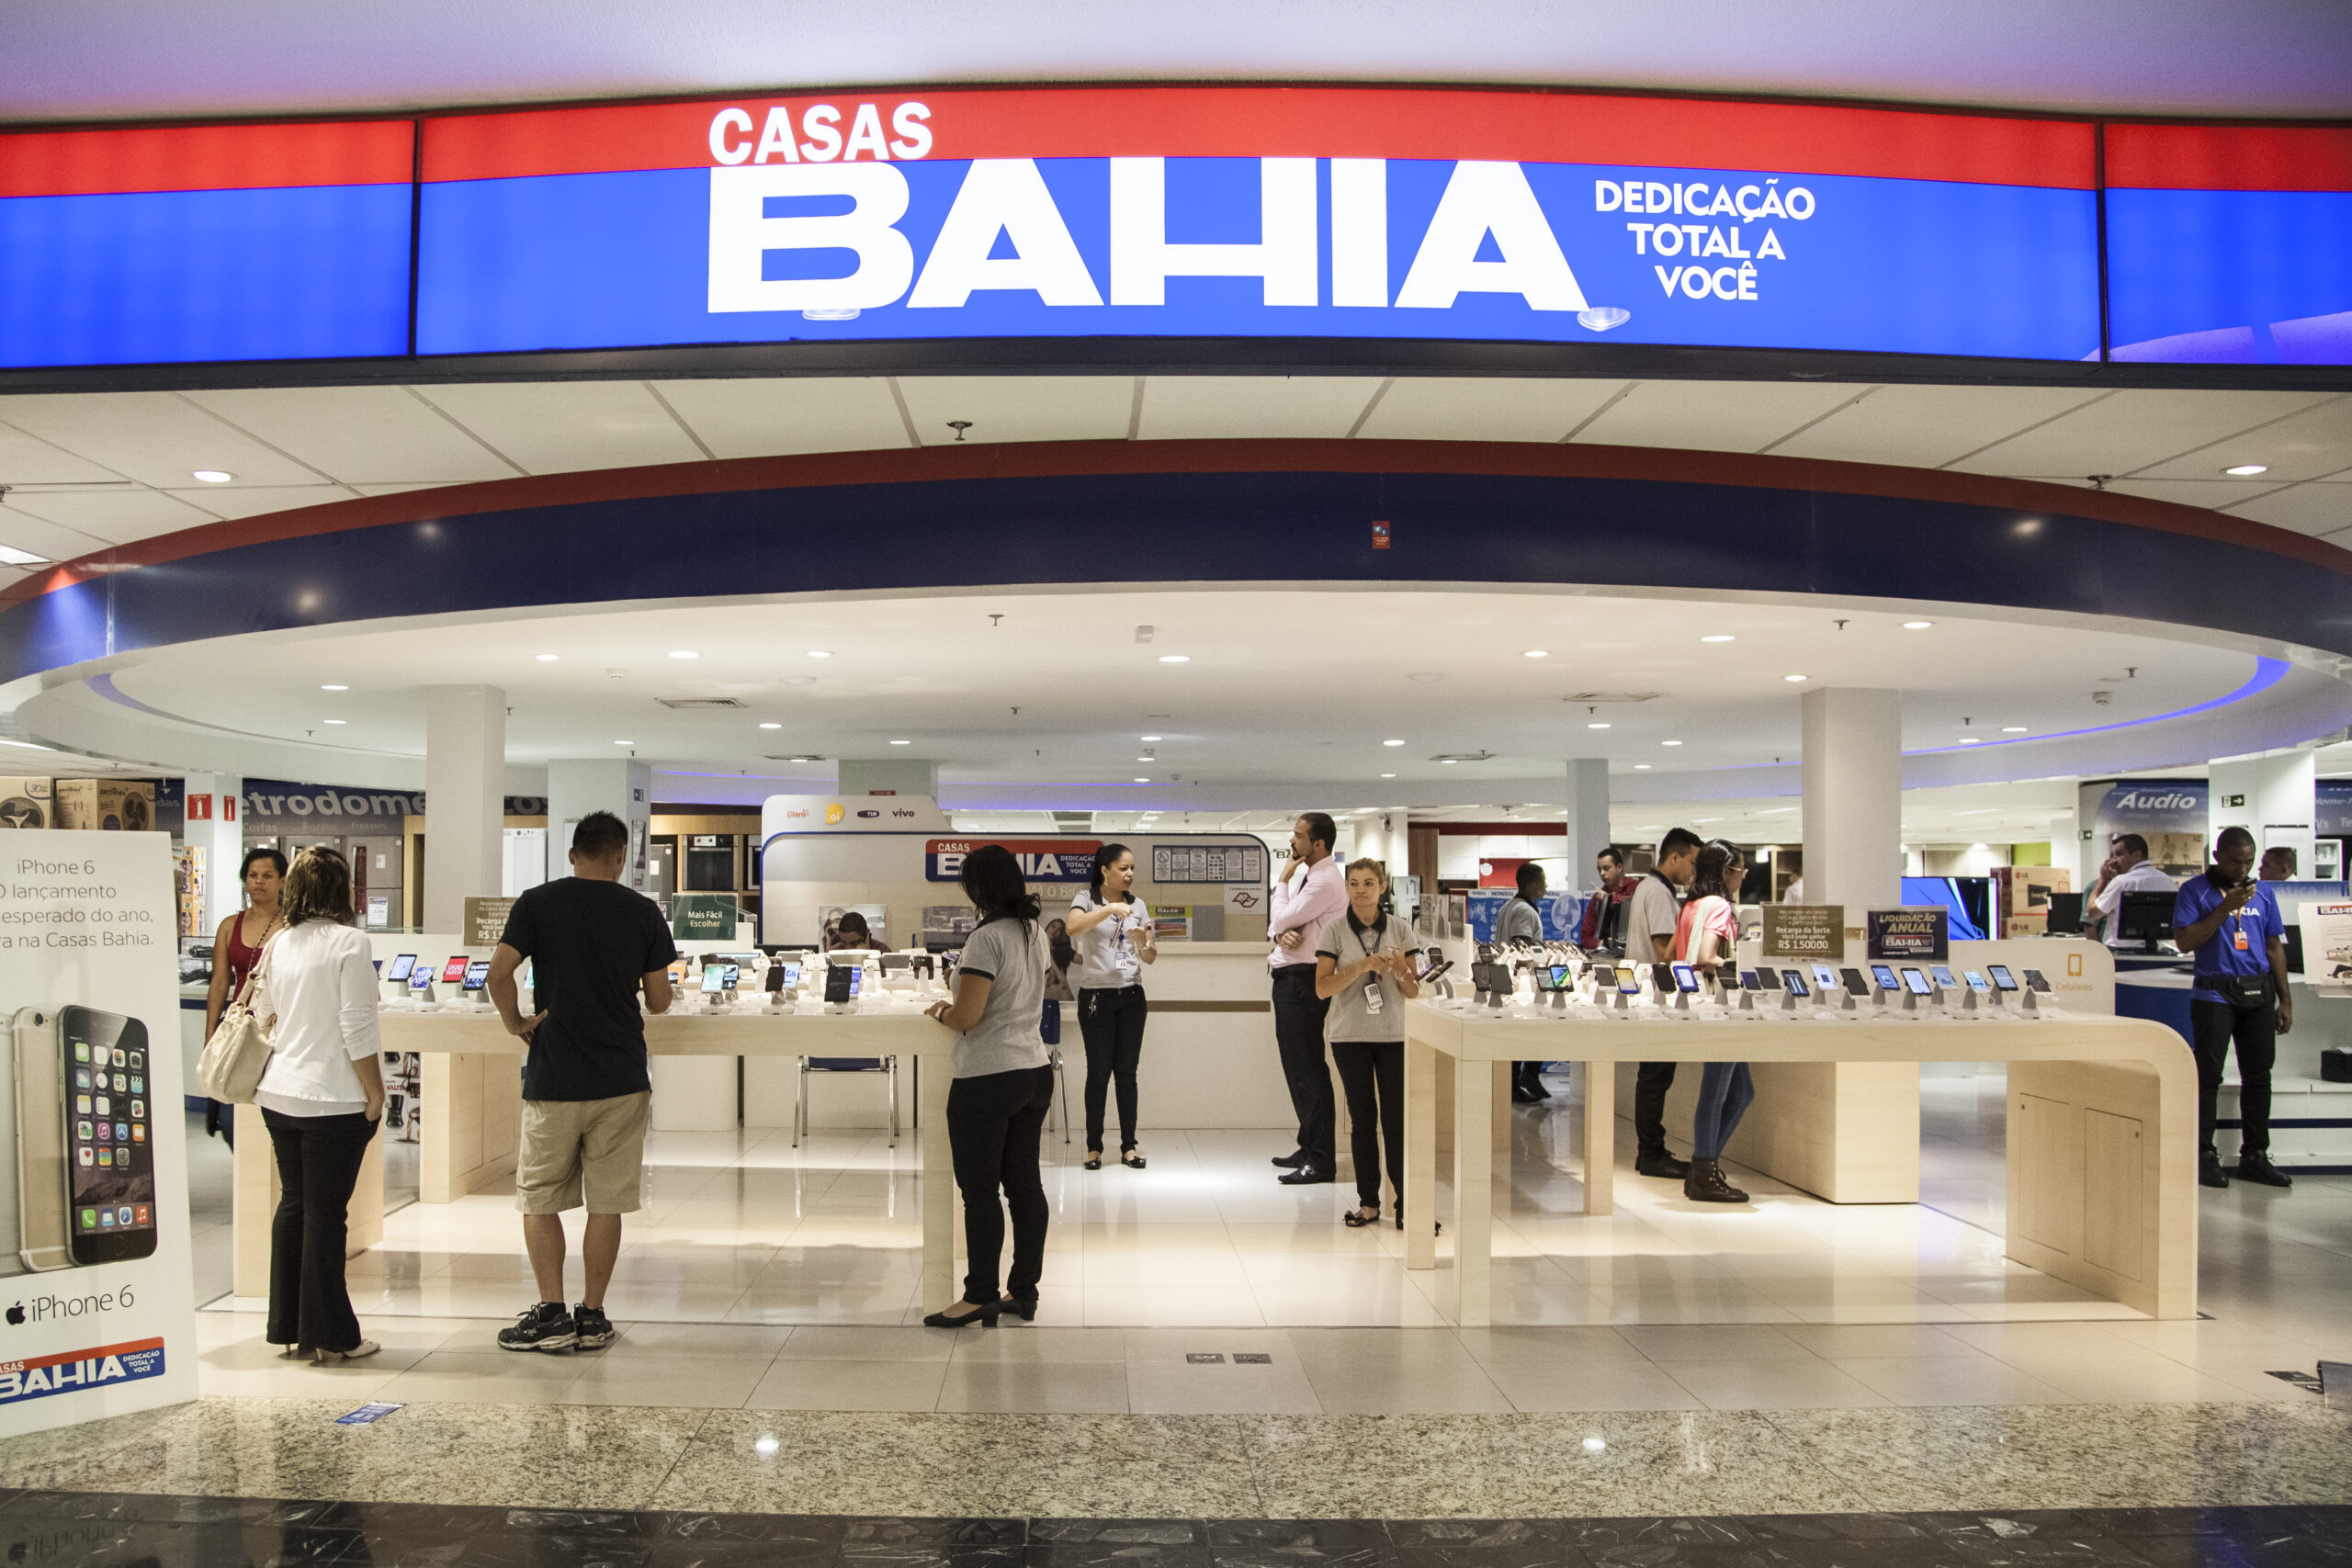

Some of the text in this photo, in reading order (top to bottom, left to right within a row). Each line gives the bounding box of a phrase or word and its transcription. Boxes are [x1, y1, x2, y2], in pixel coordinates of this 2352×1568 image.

[708, 101, 933, 165] CASAS
[1595, 178, 1815, 223] DEDICAÇÃO
[707, 157, 1590, 312] BAHIA
[1627, 222, 1786, 260] TOTAL A
[1654, 260, 1758, 300] VOCÊ
[2117, 791, 2197, 809] Áudio
[892, 808, 915, 818] vivo
[937, 842, 970, 852] CASAS
[17, 859, 96, 874] iPhone 6
[12, 883, 117, 900] lançamento
[1, 908, 153, 926] esperado do ano,
[687, 910, 705, 919] Mais
[1879, 913, 1937, 923] LIQUIDAÇÃO
[476, 918, 501, 926] Recarga
[690, 919, 720, 928] Escolher
[1887, 922, 1933, 933] ANUAL
[479, 931, 490, 940] R$
[1775, 926, 1802, 934] Recarga
[18, 936, 40, 948] na
[46, 931, 97, 948] Casas
[103, 931, 154, 946] Bahia.
[1779, 940, 1791, 949] R$
[2055, 982, 2094, 991] Celulares
[31, 1284, 134, 1322] iPhone 6
[123, 1349, 160, 1362] DEDICAÇÃO
[129, 1359, 149, 1368] TOTAL
[133, 1365, 151, 1373] VOCÊ
[0, 1355, 127, 1398] BAHIA
